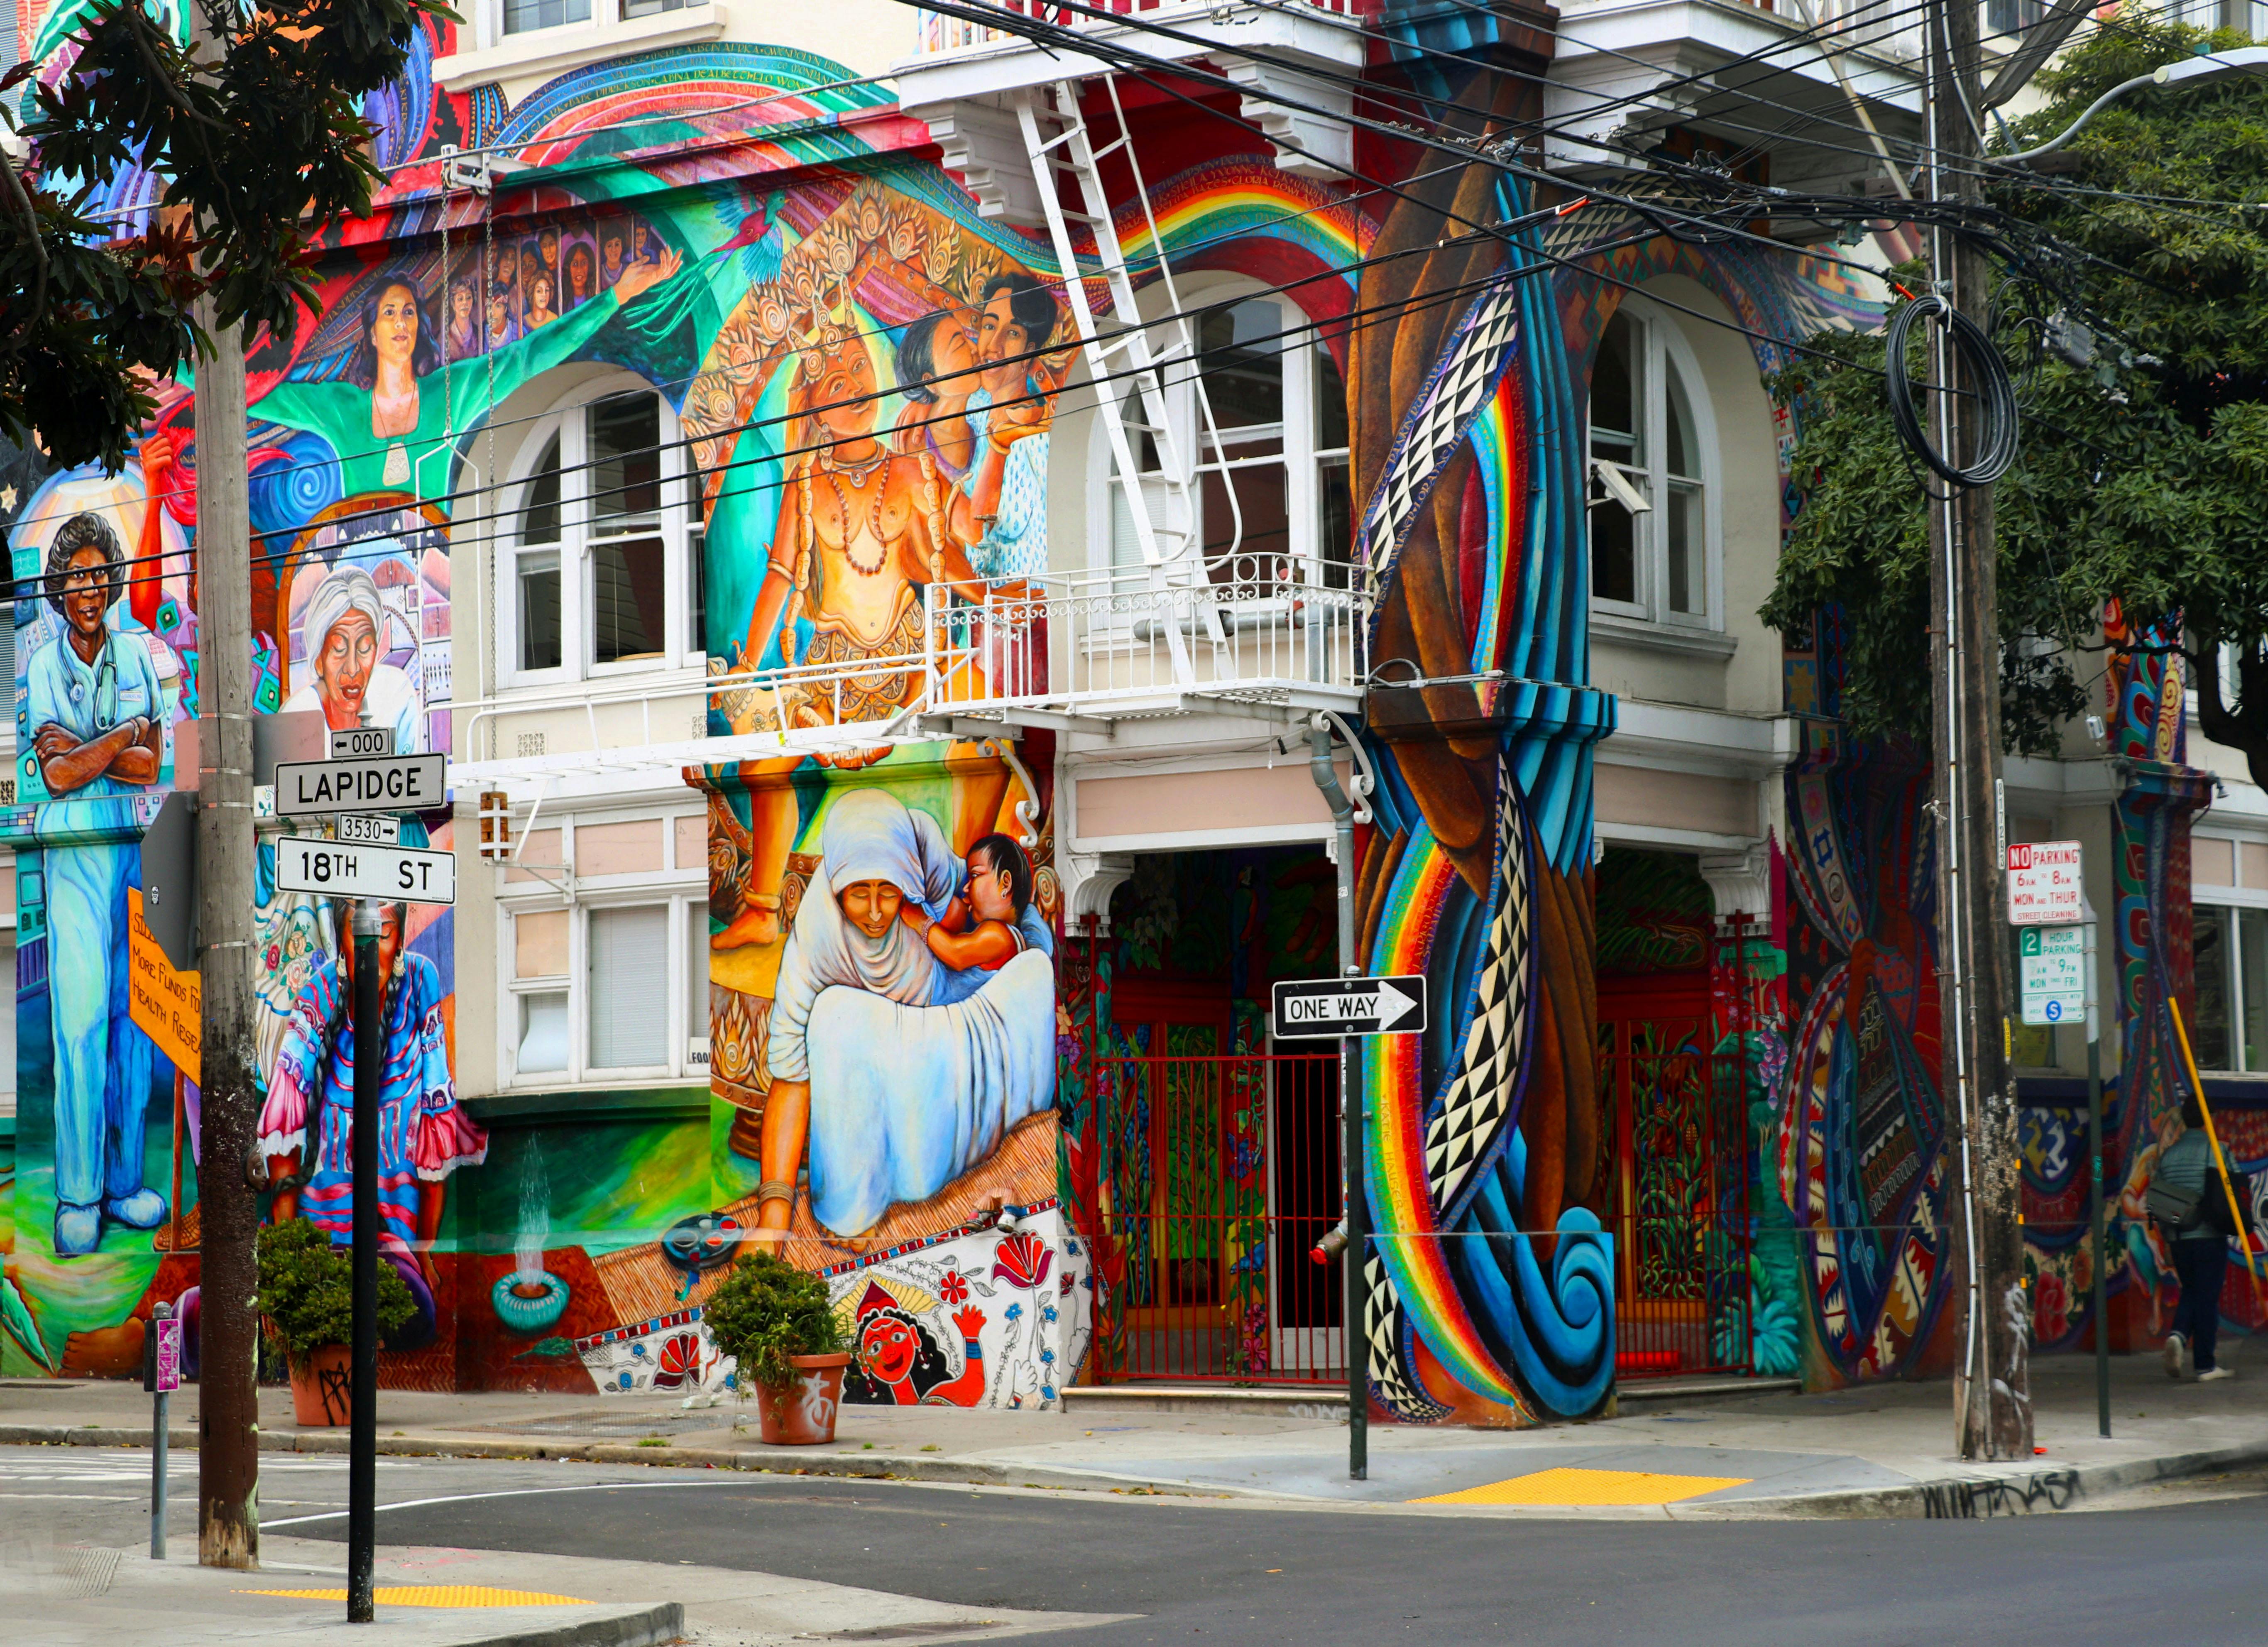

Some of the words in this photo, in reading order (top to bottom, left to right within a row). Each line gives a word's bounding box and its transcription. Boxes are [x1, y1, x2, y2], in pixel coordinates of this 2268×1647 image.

[824, 59, 855, 81] BROOK
[298, 767, 421, 803] LAPIDGE
[345, 818, 381, 840] 3530
[2010, 847, 2030, 867] NO
[2033, 849, 2078, 865] PARKING
[302, 852, 357, 882] 18TH
[399, 860, 432, 890] ST
[2015, 893, 2034, 905] MON
[2050, 891, 2077, 904] THUR
[2018, 911, 2041, 920] STREET
[2043, 910, 2077, 919] CLEANING
[2026, 932, 2037, 952] 2
[2050, 932, 2074, 942] HOUR
[2043, 944, 2081, 955] PARKING
[133, 944, 155, 979] MORE
[159, 962, 186, 1001] FUNDS
[191, 985, 200, 1013] FO
[2029, 978, 2046, 988] MON
[2065, 976, 2077, 986] FRI
[133, 976, 166, 1024] HEALTH
[173, 1011, 201, 1054] RESEA
[1291, 998, 1330, 1020] ONE
[1338, 996, 1380, 1018] WAY
[2049, 1003, 2059, 1018] S
[1381, 1102, 1392, 1142] KATIE
[1384, 1151, 1403, 1209] HAUSER
